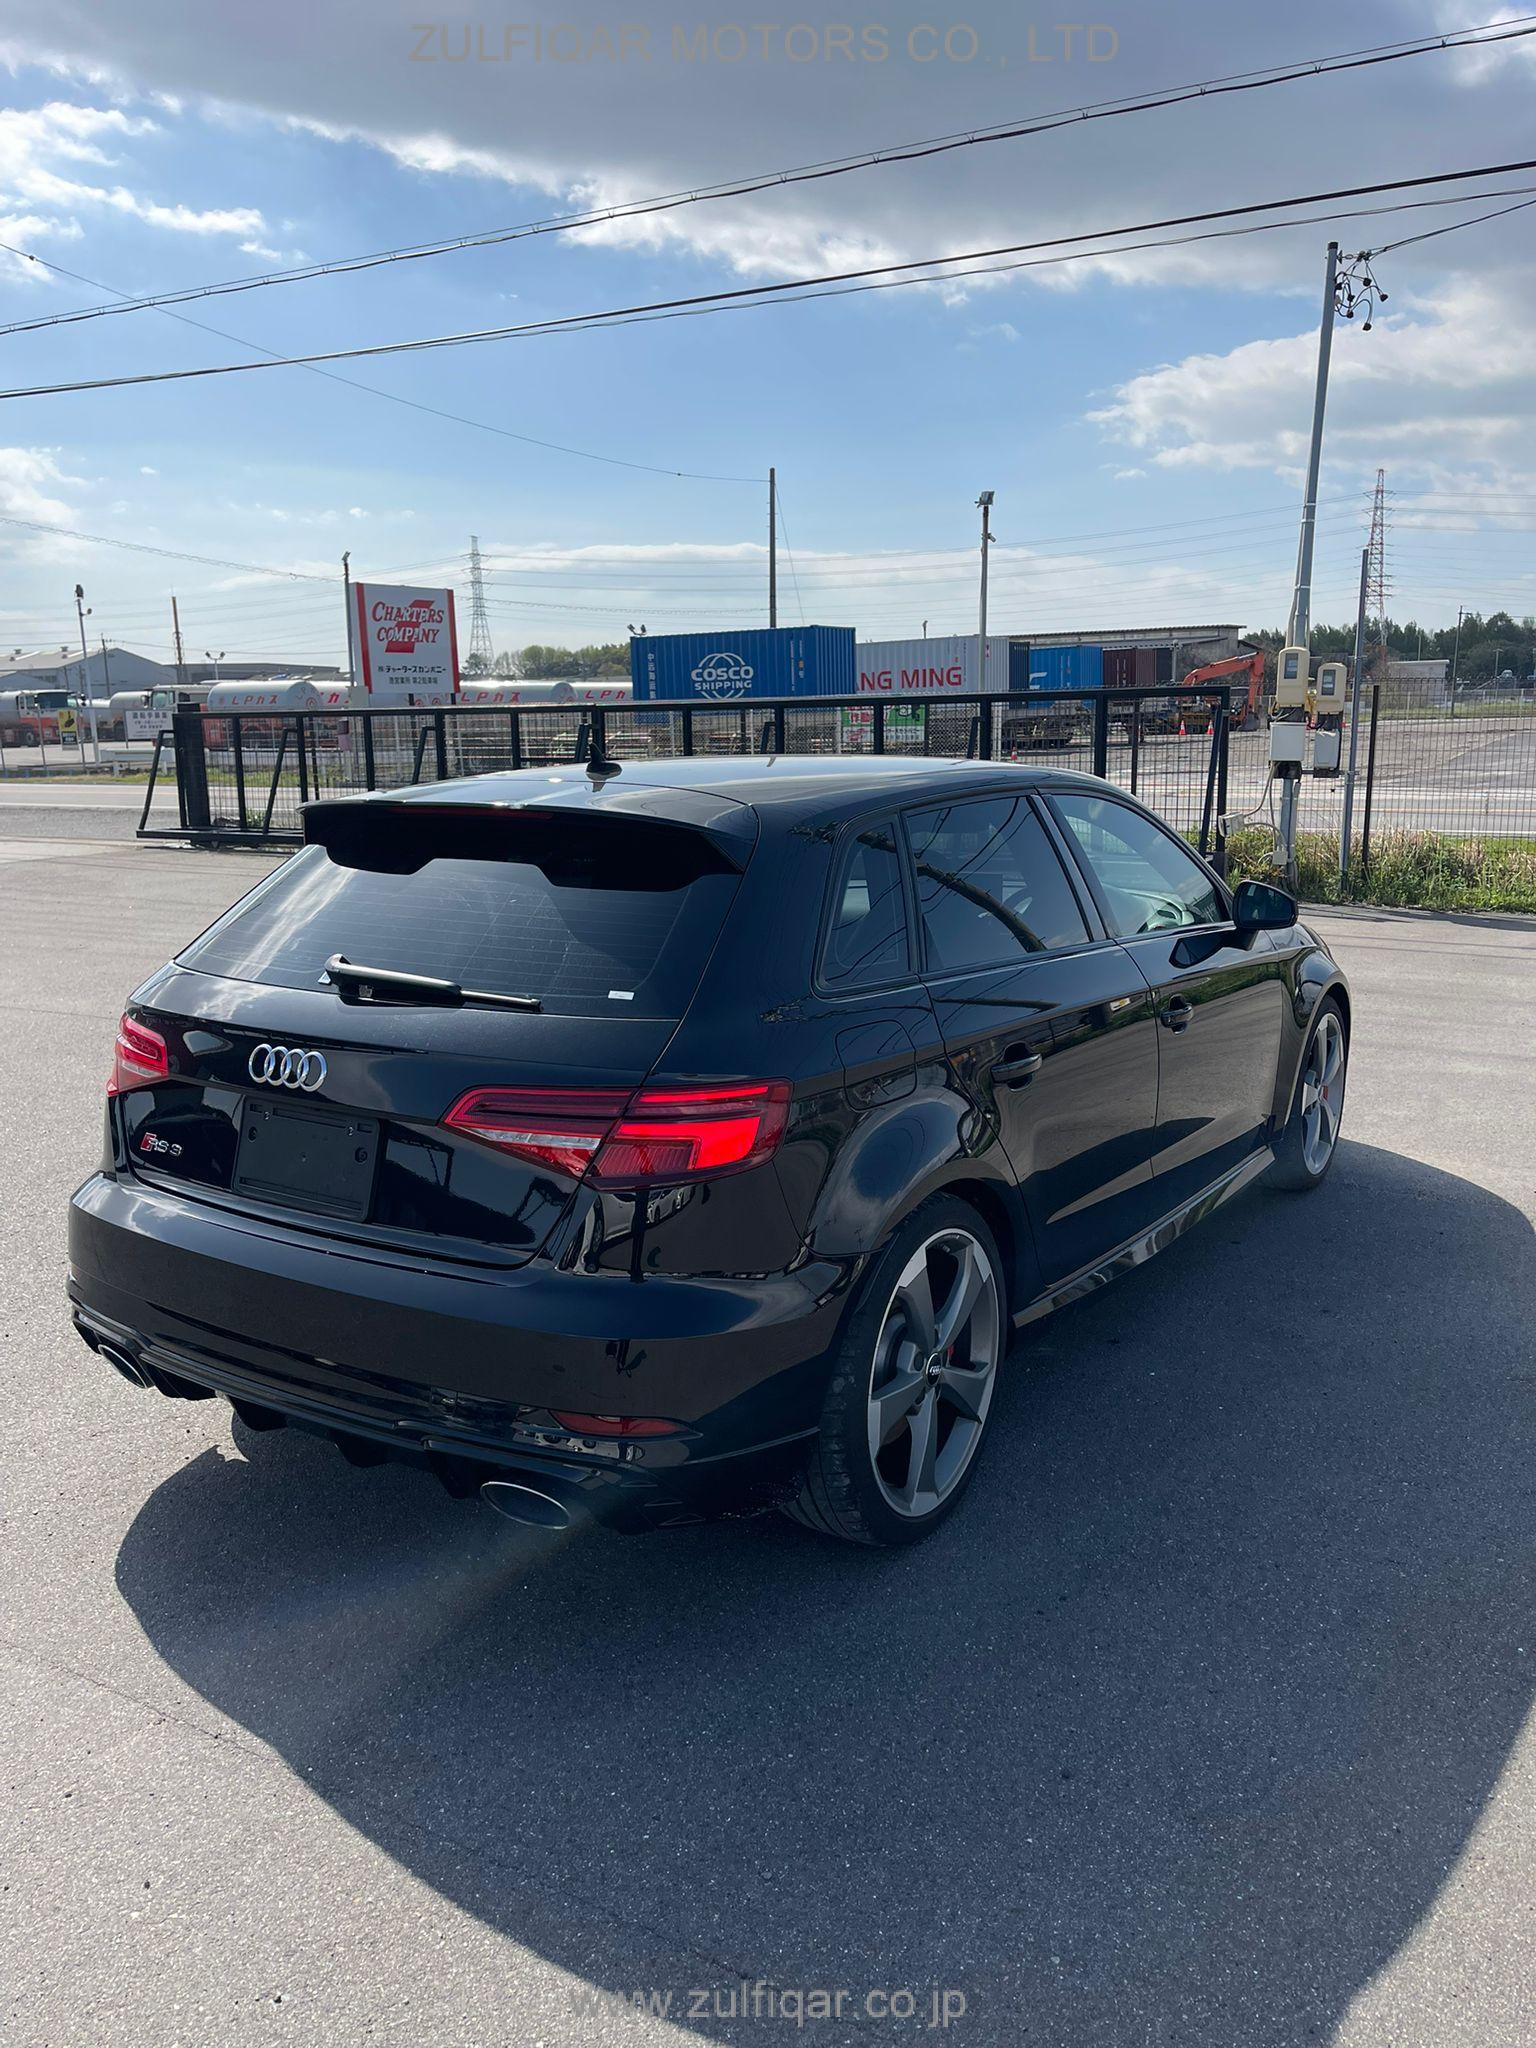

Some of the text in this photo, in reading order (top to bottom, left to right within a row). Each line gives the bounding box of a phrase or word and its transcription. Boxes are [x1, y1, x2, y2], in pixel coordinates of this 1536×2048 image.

[371, 601, 445, 624] CHARTERS
[376, 626, 441, 643] COMPANY
[691, 665, 754, 681] COSCO
[901, 666, 962, 689] MING
[694, 680, 753, 691] SHIPPING
